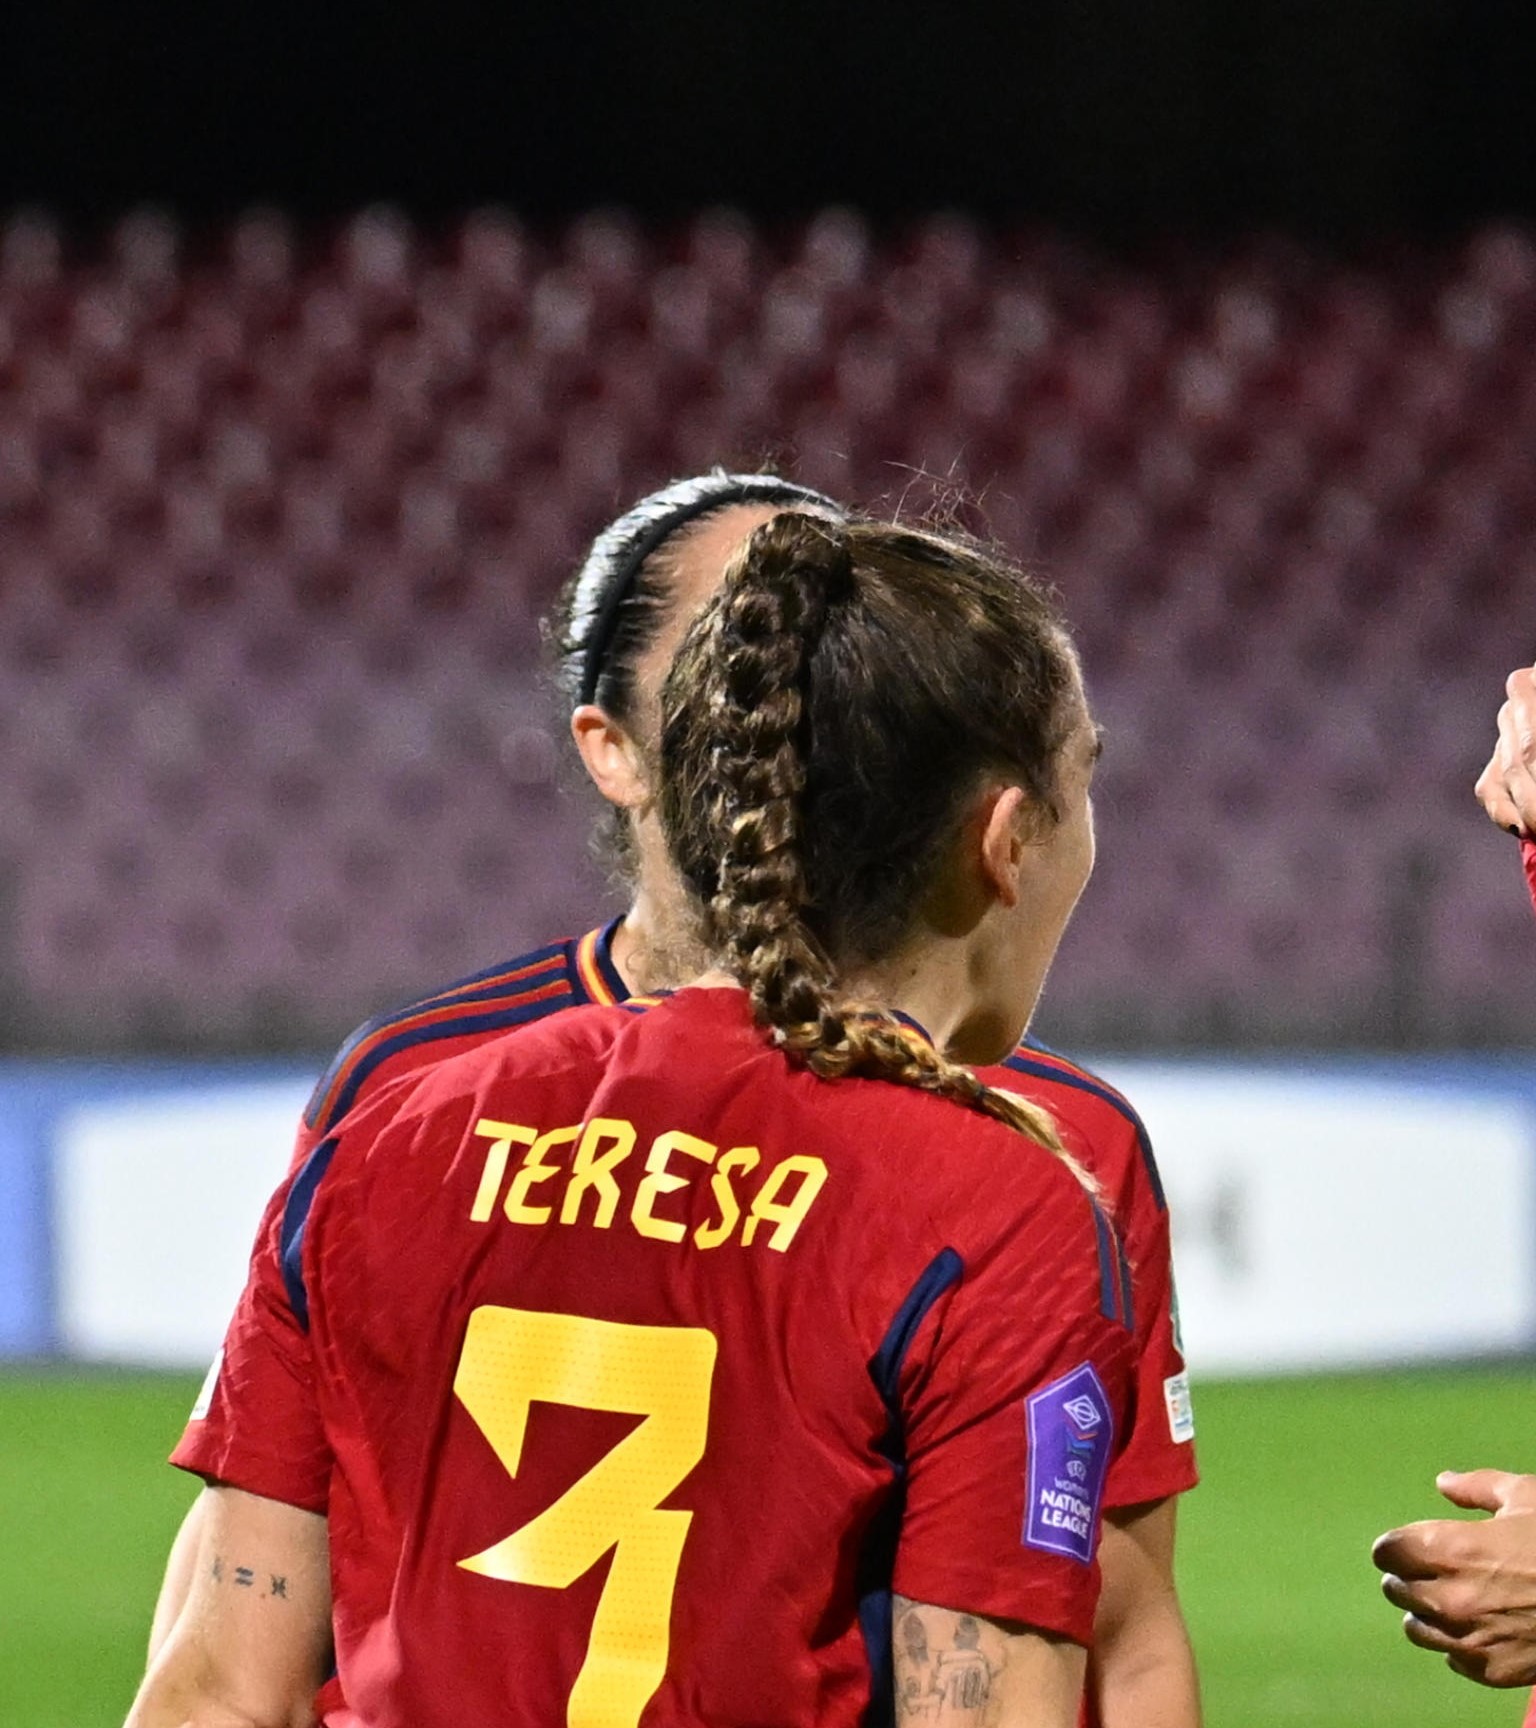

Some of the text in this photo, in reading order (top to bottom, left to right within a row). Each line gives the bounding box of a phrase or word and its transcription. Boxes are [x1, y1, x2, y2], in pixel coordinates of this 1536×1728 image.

[470, 1117, 829, 1253] TERESA
[453, 1304, 718, 1728] 7
[1040, 1488, 1091, 1522] NATIONS
[1041, 1507, 1088, 1539] LEAGUE
